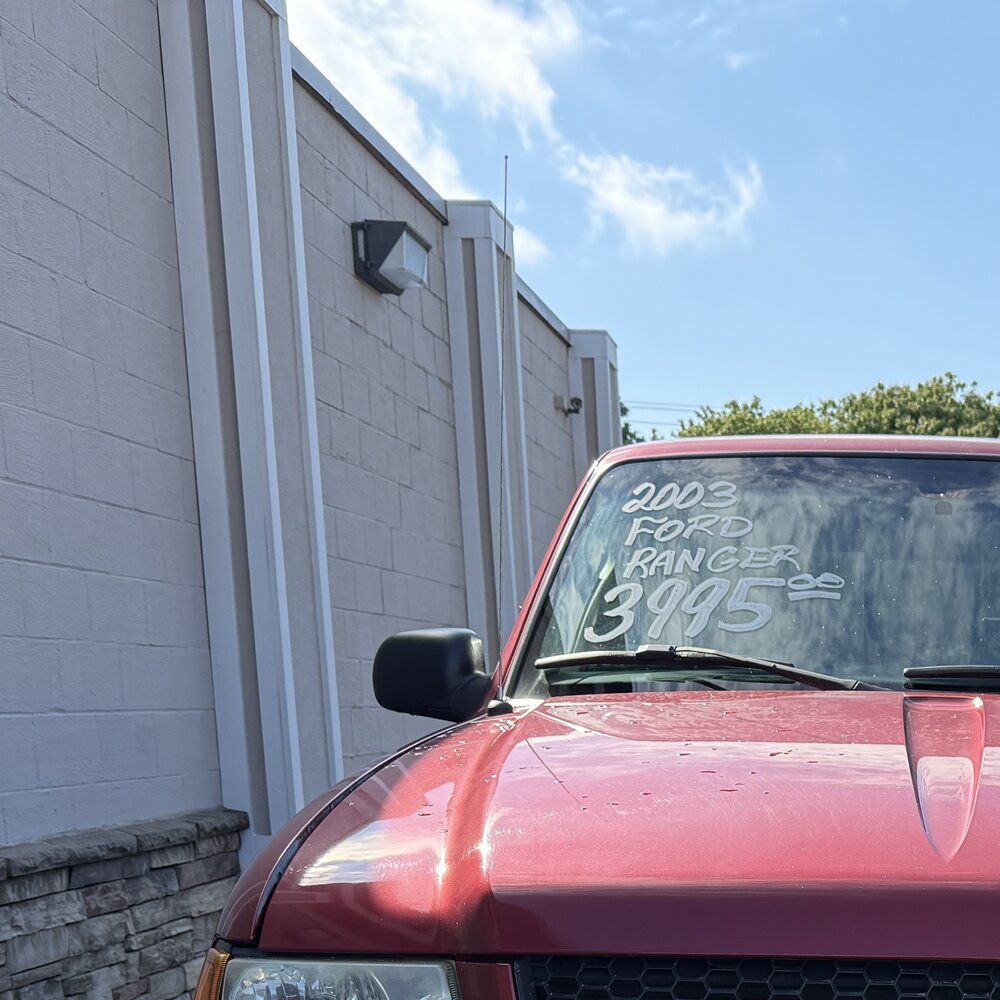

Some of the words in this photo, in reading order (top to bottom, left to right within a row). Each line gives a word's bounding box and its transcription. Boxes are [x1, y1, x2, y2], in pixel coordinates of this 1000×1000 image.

[622, 481, 737, 513] 2003
[624, 514, 753, 546] FORD
[623, 544, 800, 579] RANGER
[584, 577, 786, 643] 3995
